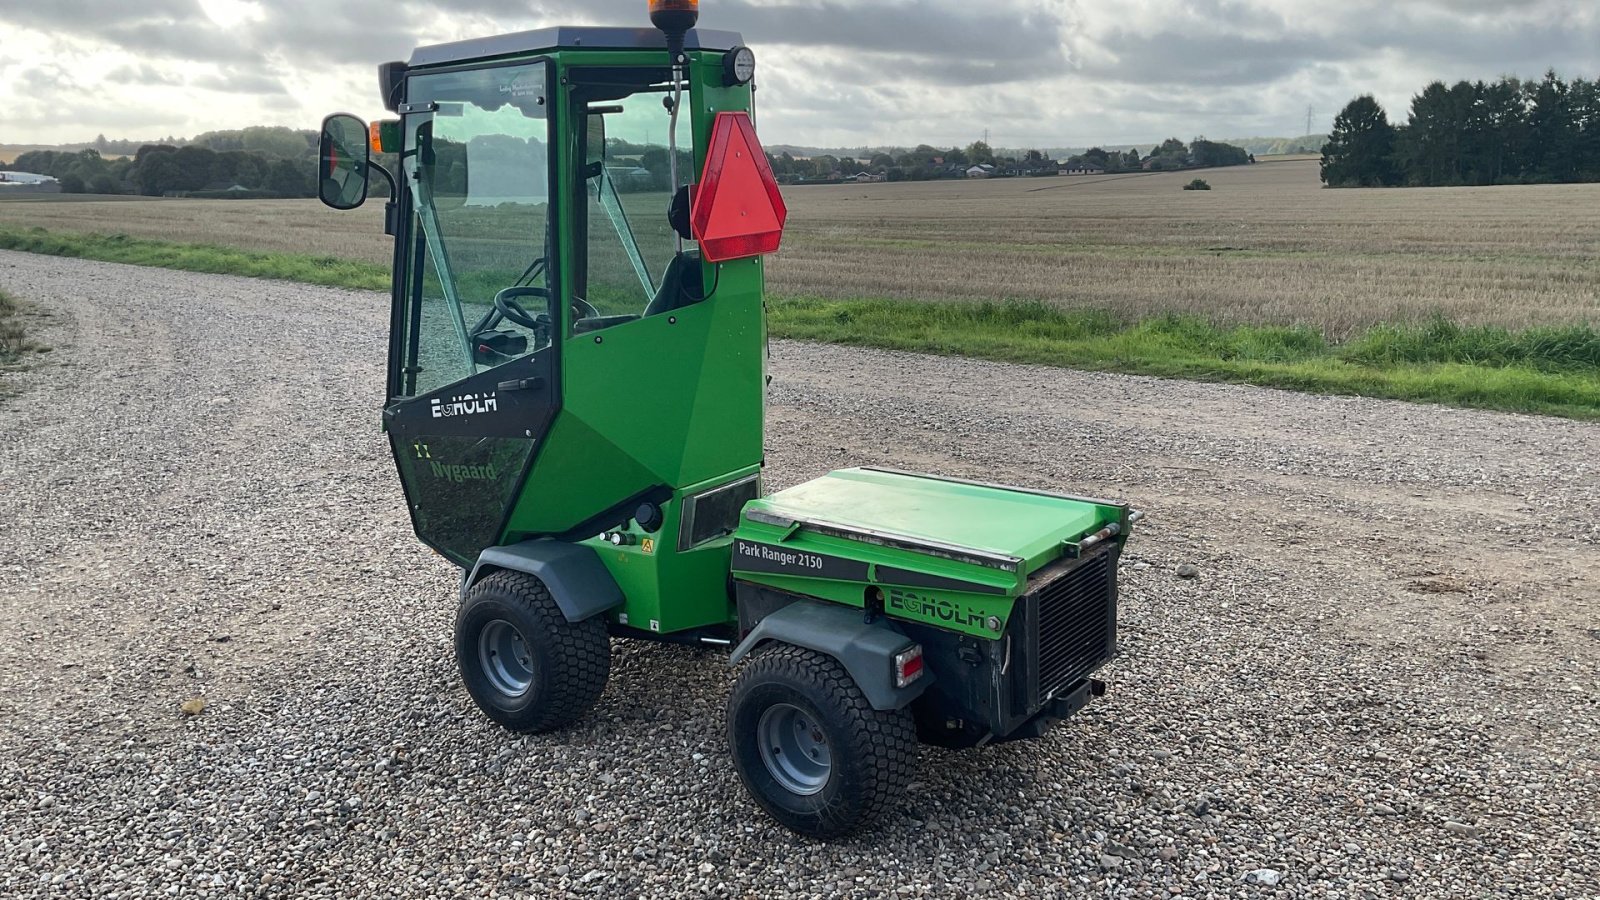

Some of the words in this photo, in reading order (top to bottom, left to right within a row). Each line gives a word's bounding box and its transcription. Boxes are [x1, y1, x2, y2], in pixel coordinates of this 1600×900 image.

[431, 391, 497, 418] EGHOLM
[430, 460, 497, 482] Nygaard
[739, 541, 760, 558] Park
[762, 546, 797, 566] Ranger
[798, 553, 823, 570] 2150
[890, 589, 985, 629] EGHOLM
